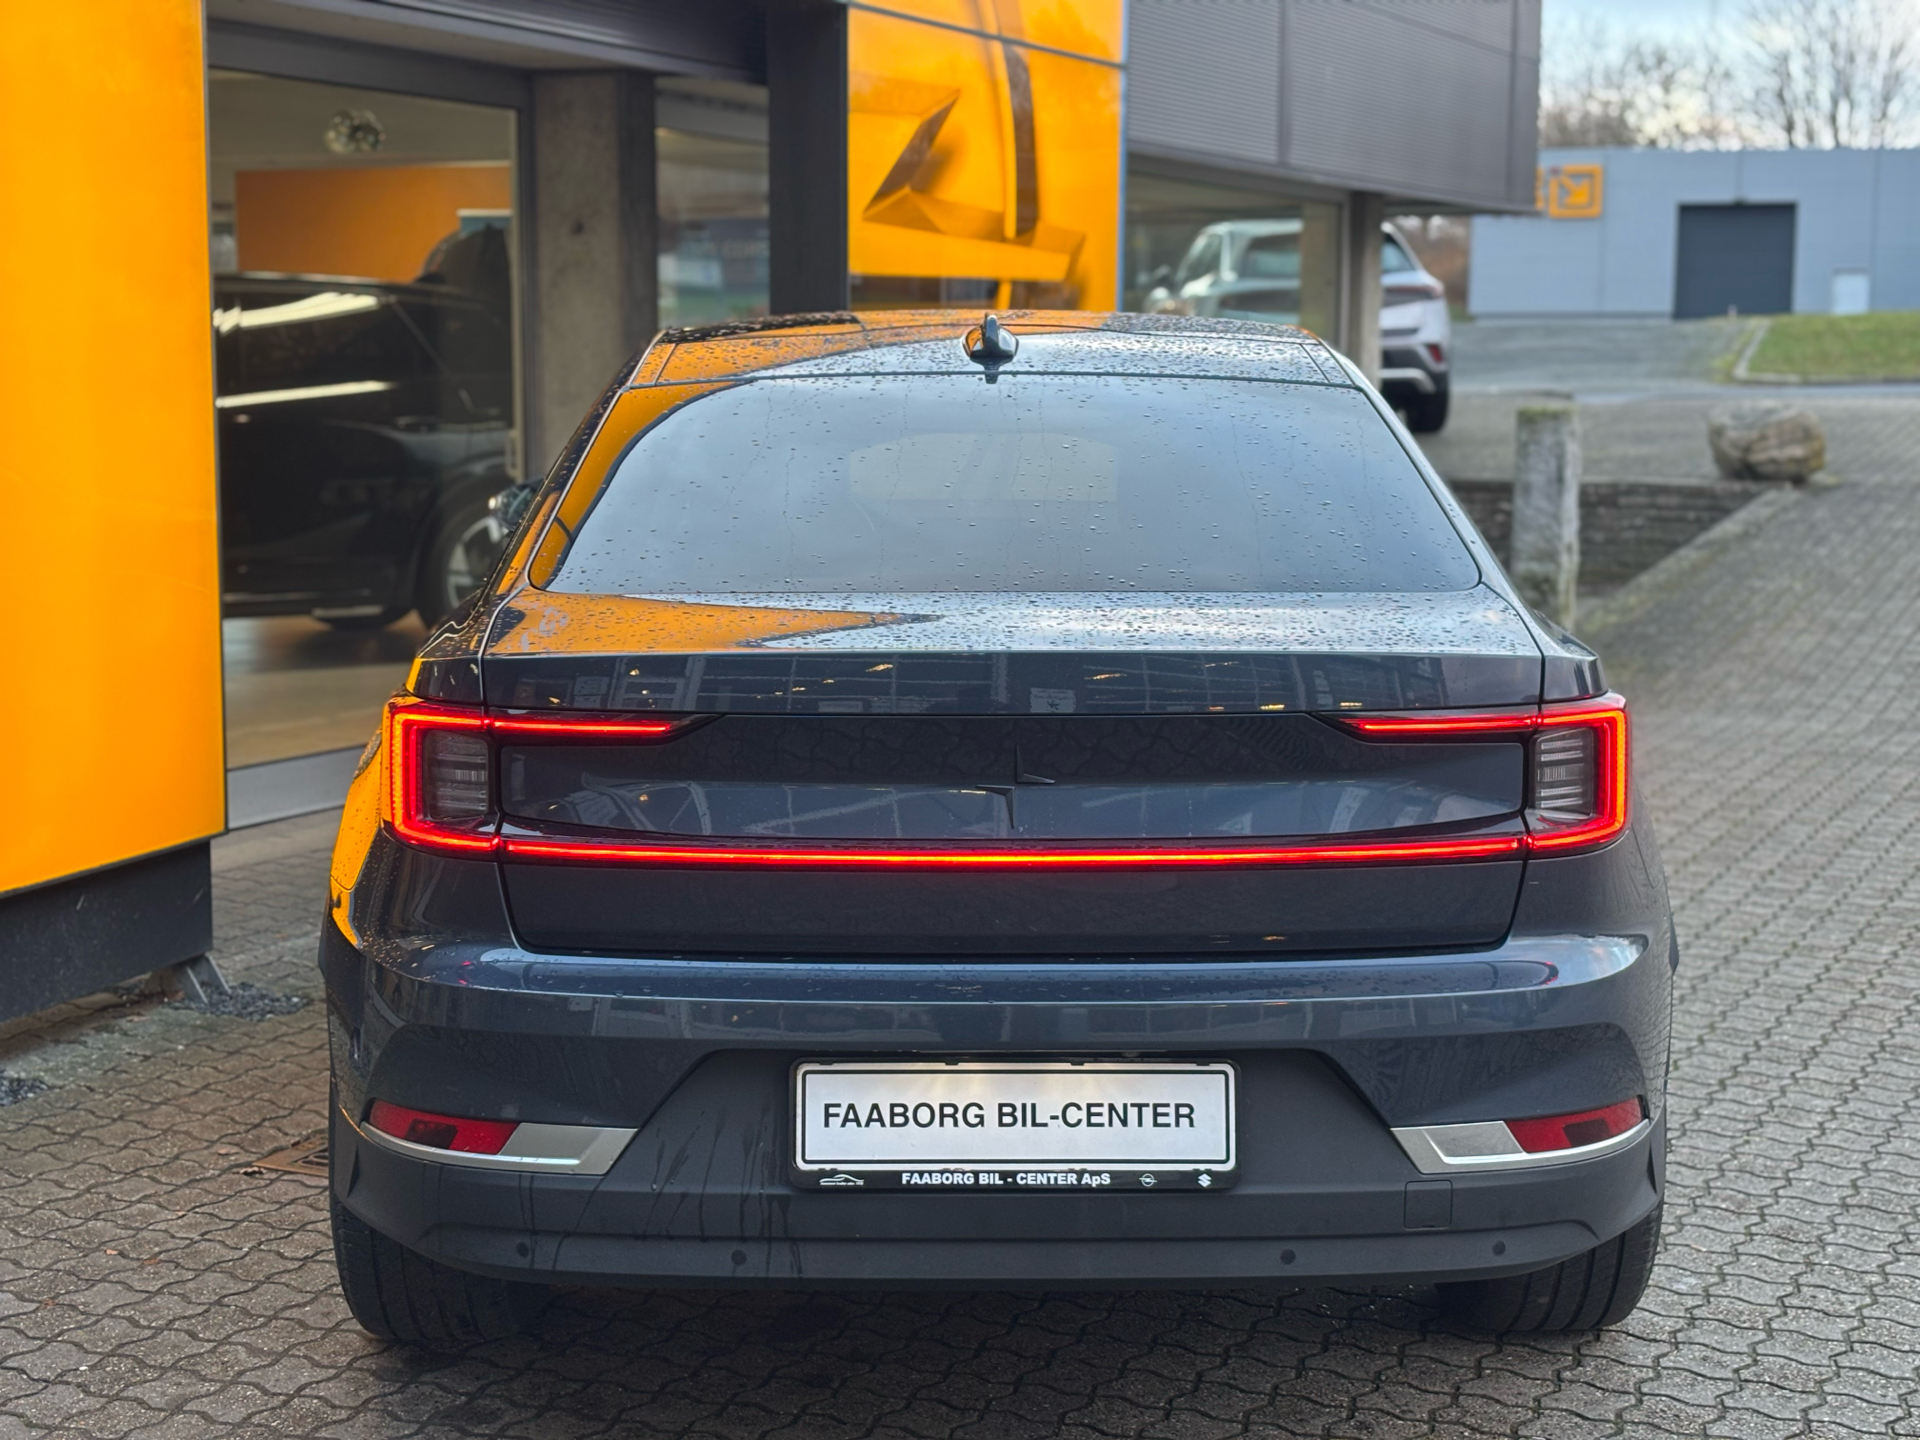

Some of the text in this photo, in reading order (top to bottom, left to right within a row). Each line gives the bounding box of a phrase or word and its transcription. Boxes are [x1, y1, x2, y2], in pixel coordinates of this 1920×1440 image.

[823, 1102, 1195, 1128] FAABORG BIL-CENTER
[901, 1172, 975, 1185] FAABORG
[978, 1172, 1004, 1185] BIL
[1015, 1172, 1078, 1185] CENTER
[1080, 1172, 1111, 1188] ApS
